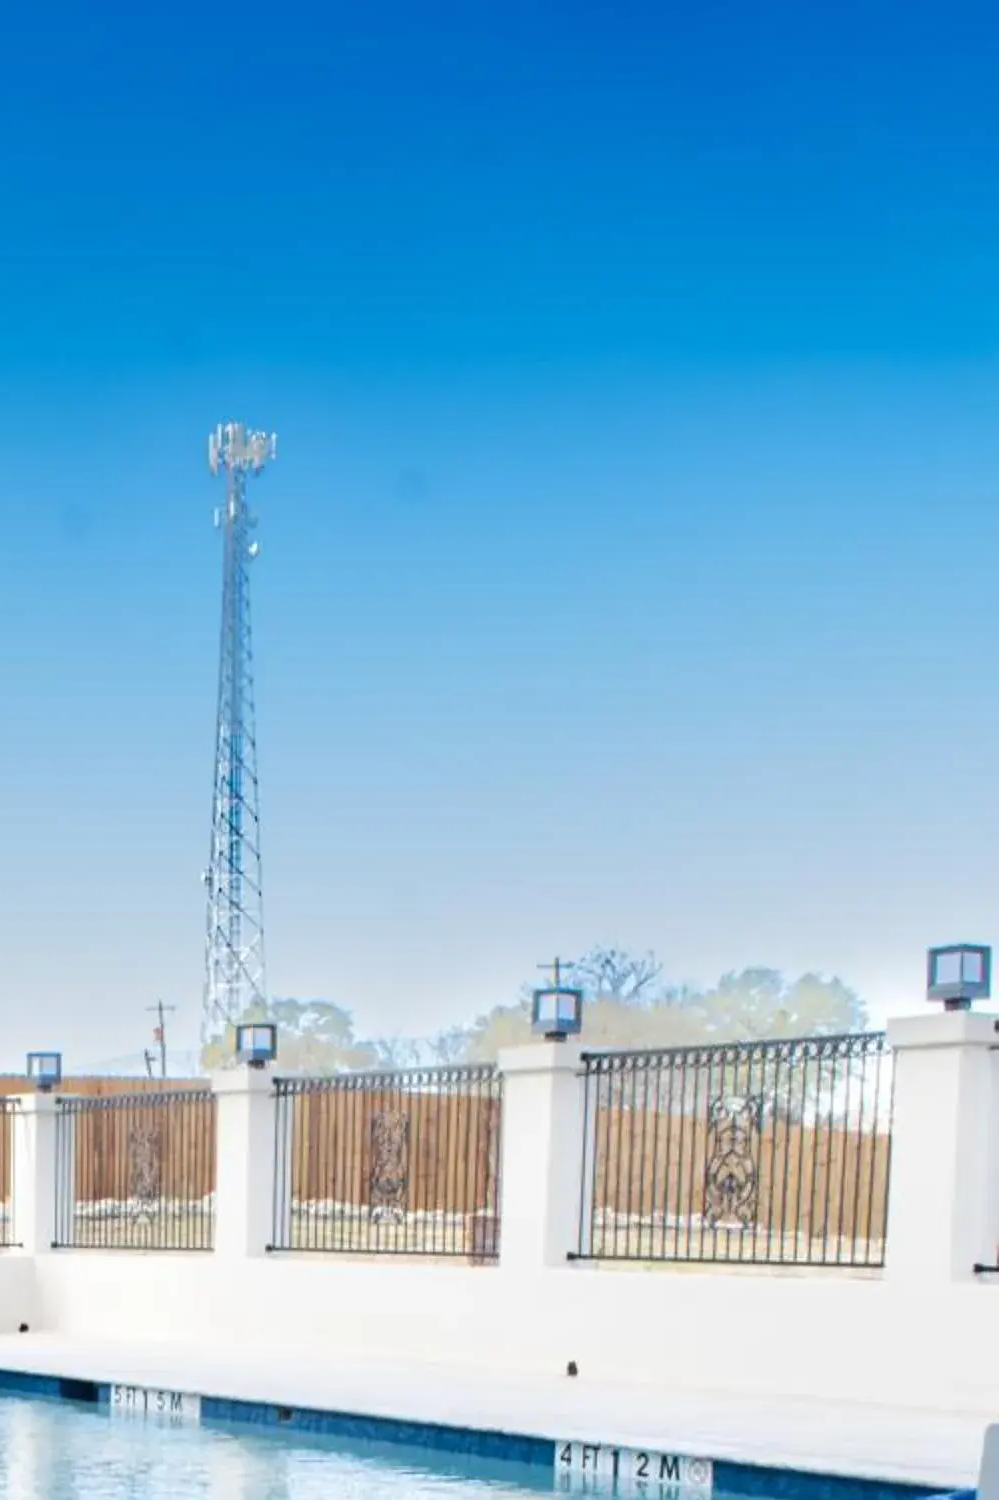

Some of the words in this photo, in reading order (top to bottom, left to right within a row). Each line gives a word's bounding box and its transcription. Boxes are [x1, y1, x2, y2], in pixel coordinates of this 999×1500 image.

[560, 1443, 572, 1466] 4
[582, 1444, 601, 1471] FT
[636, 1452, 649, 1478] 2
[659, 1455, 680, 1481] M
